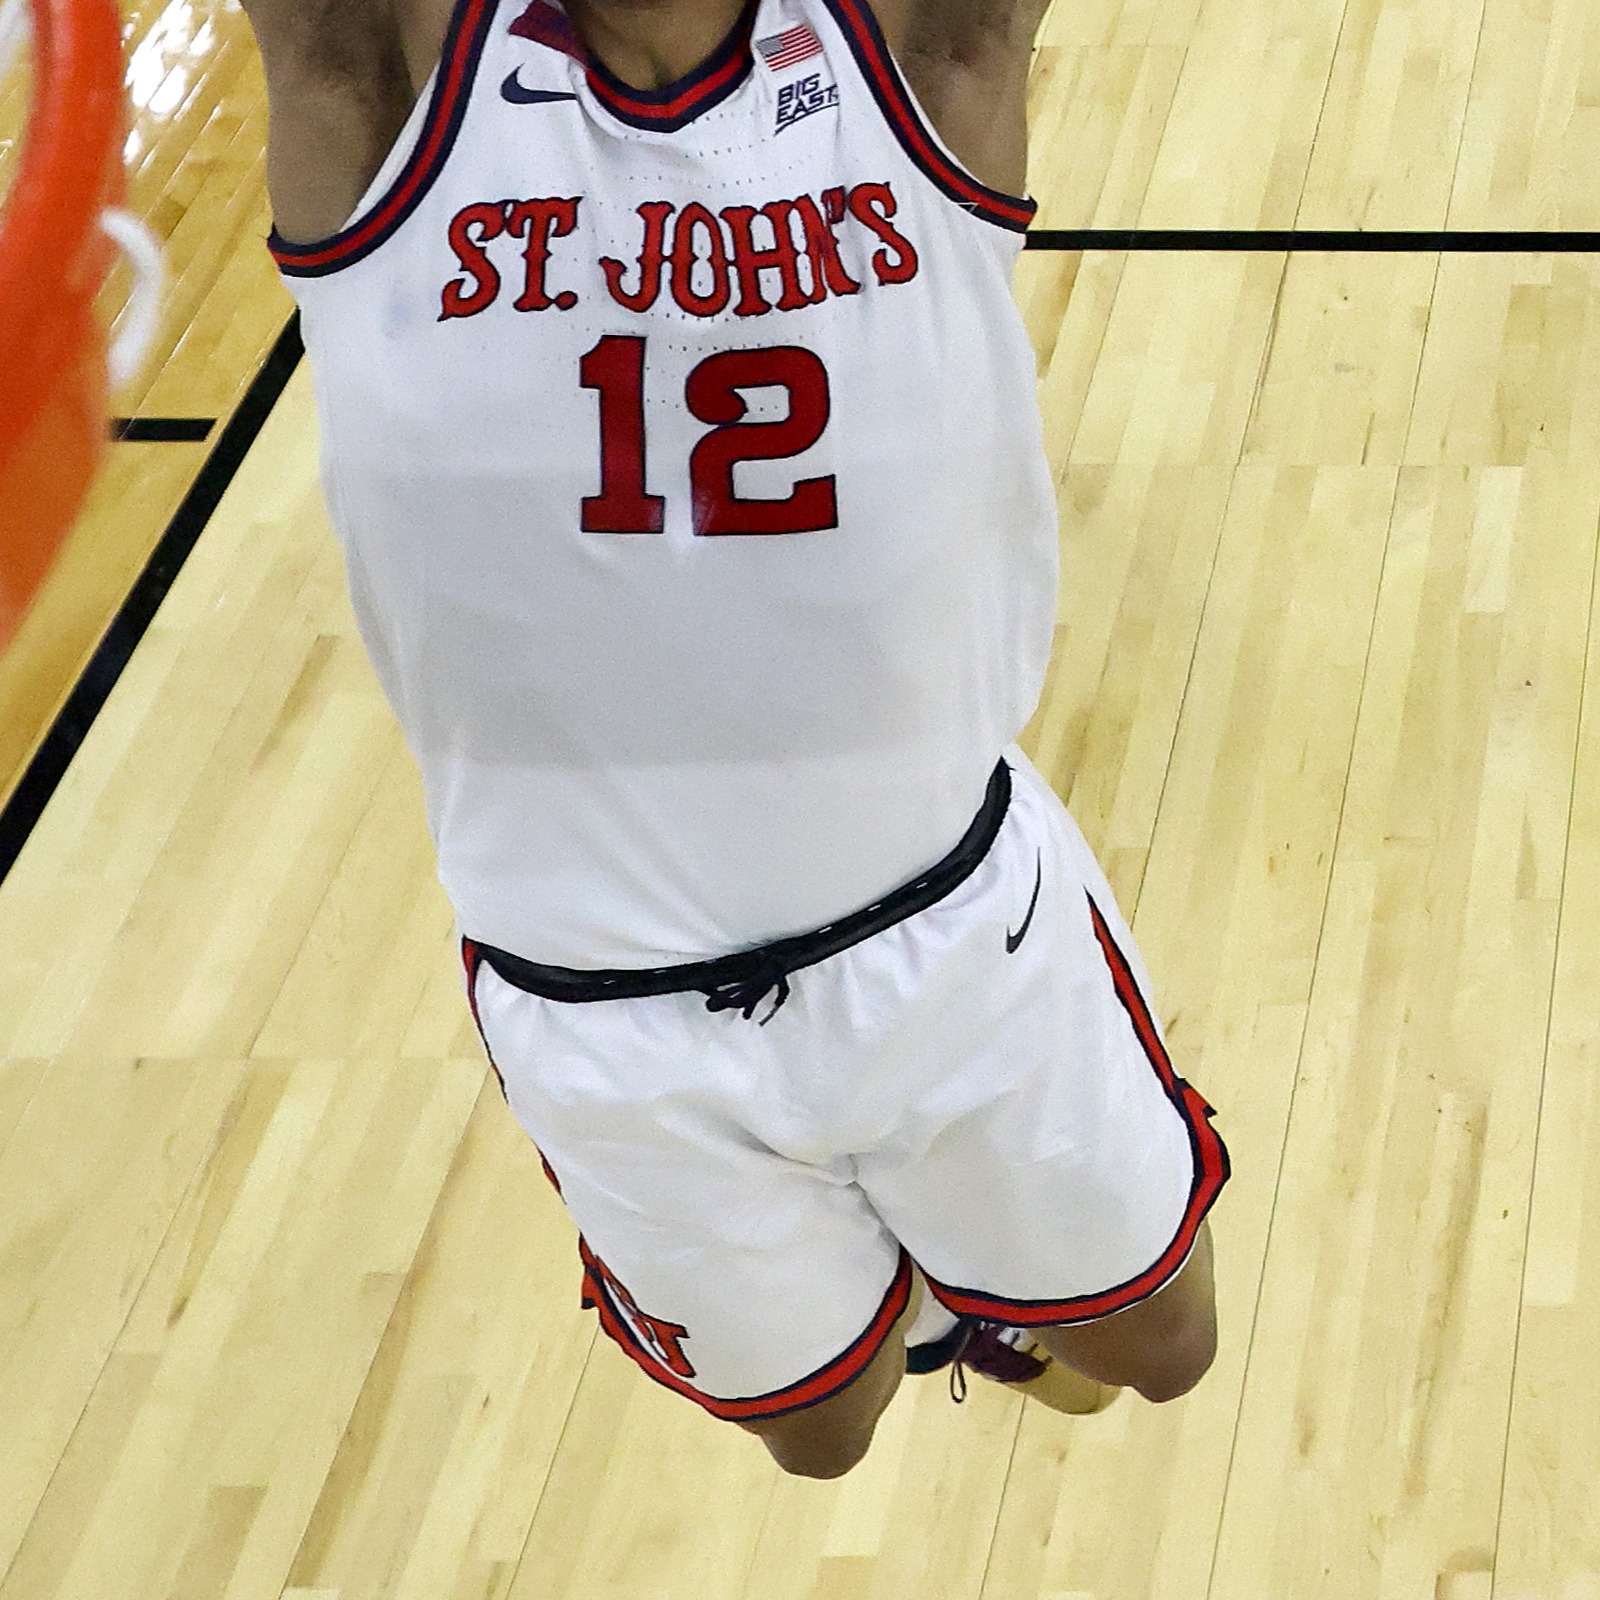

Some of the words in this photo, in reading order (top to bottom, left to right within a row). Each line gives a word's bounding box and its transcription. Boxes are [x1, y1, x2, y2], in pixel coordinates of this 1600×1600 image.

[775, 84, 839, 126] EAST
[777, 72, 821, 107] BIG
[437, 197, 584, 323] ST.
[600, 180, 920, 319] JOHN'S
[579, 334, 840, 537] 12
